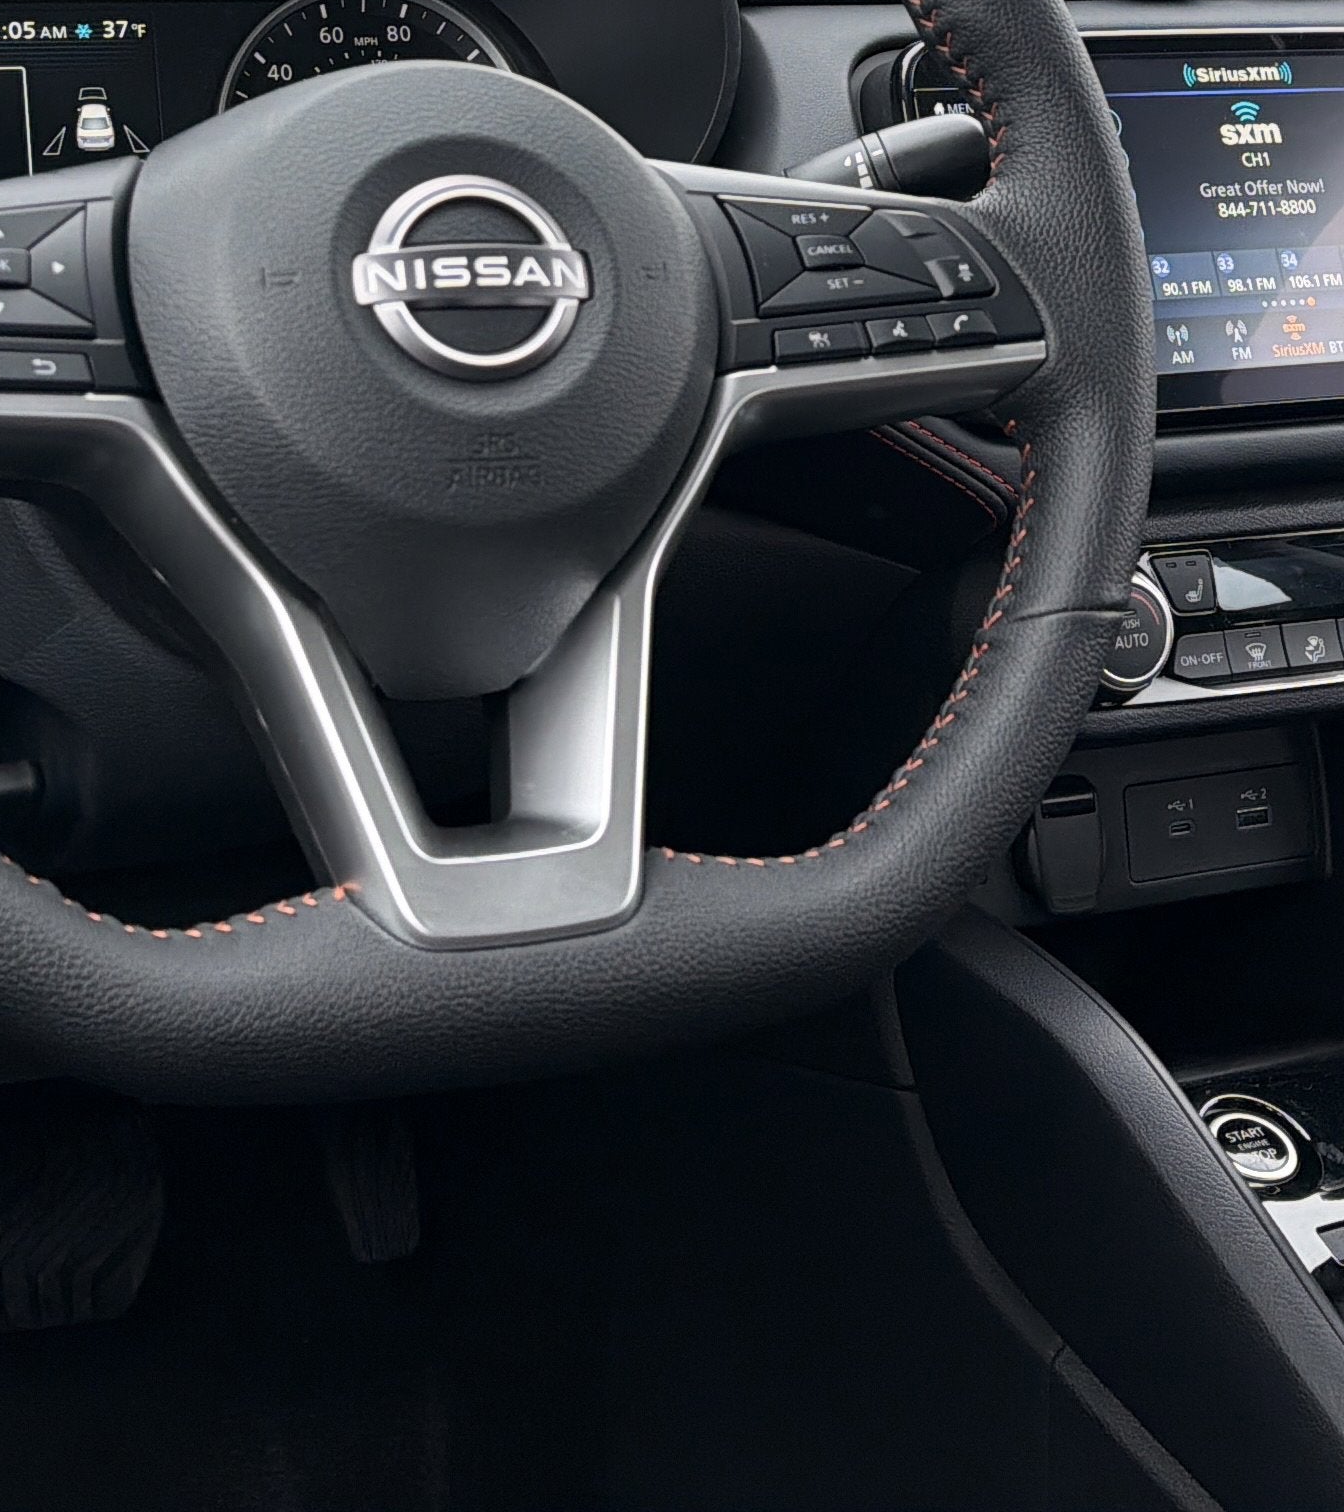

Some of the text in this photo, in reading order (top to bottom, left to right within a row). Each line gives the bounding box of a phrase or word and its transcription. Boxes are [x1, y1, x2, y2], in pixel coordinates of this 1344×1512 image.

[40, 25, 68, 39] AM
[320, 27, 344, 44] 60
[387, 25, 411, 42] 80
[354, 37, 379, 47] MPH
[267, 64, 293, 81] 40
[1241, 152, 1271, 168] CH1
[1200, 178, 1326, 198] Great Offer Now!
[1218, 198, 1316, 218] 844-711-8800
[791, 213, 816, 224] RES
[807, 244, 853, 255] CANCEL
[1151, 260, 1170, 275] 32
[1216, 256, 1235, 271] 33
[1281, 253, 1298, 268] 34
[365, 256, 586, 293] NISSAN
[1288, 273, 1343, 288] 106.1 FM
[827, 277, 849, 290] SET
[1162, 280, 1213, 296] 90.1 FM
[1227, 277, 1277, 292] 98.1 FM
[1231, 346, 1253, 361] FM
[1272, 341, 1326, 358] SiriusXM
[1329, 341, 1344, 354] BT
[1172, 350, 1195, 365] AM
[1114, 633, 1149, 650] AUTO
[1248, 661, 1272, 669] FRONT
[1261, 788, 1267, 799] 2
[1225, 1127, 1265, 1143] START
[1237, 1139, 1270, 1151] ENGINE
